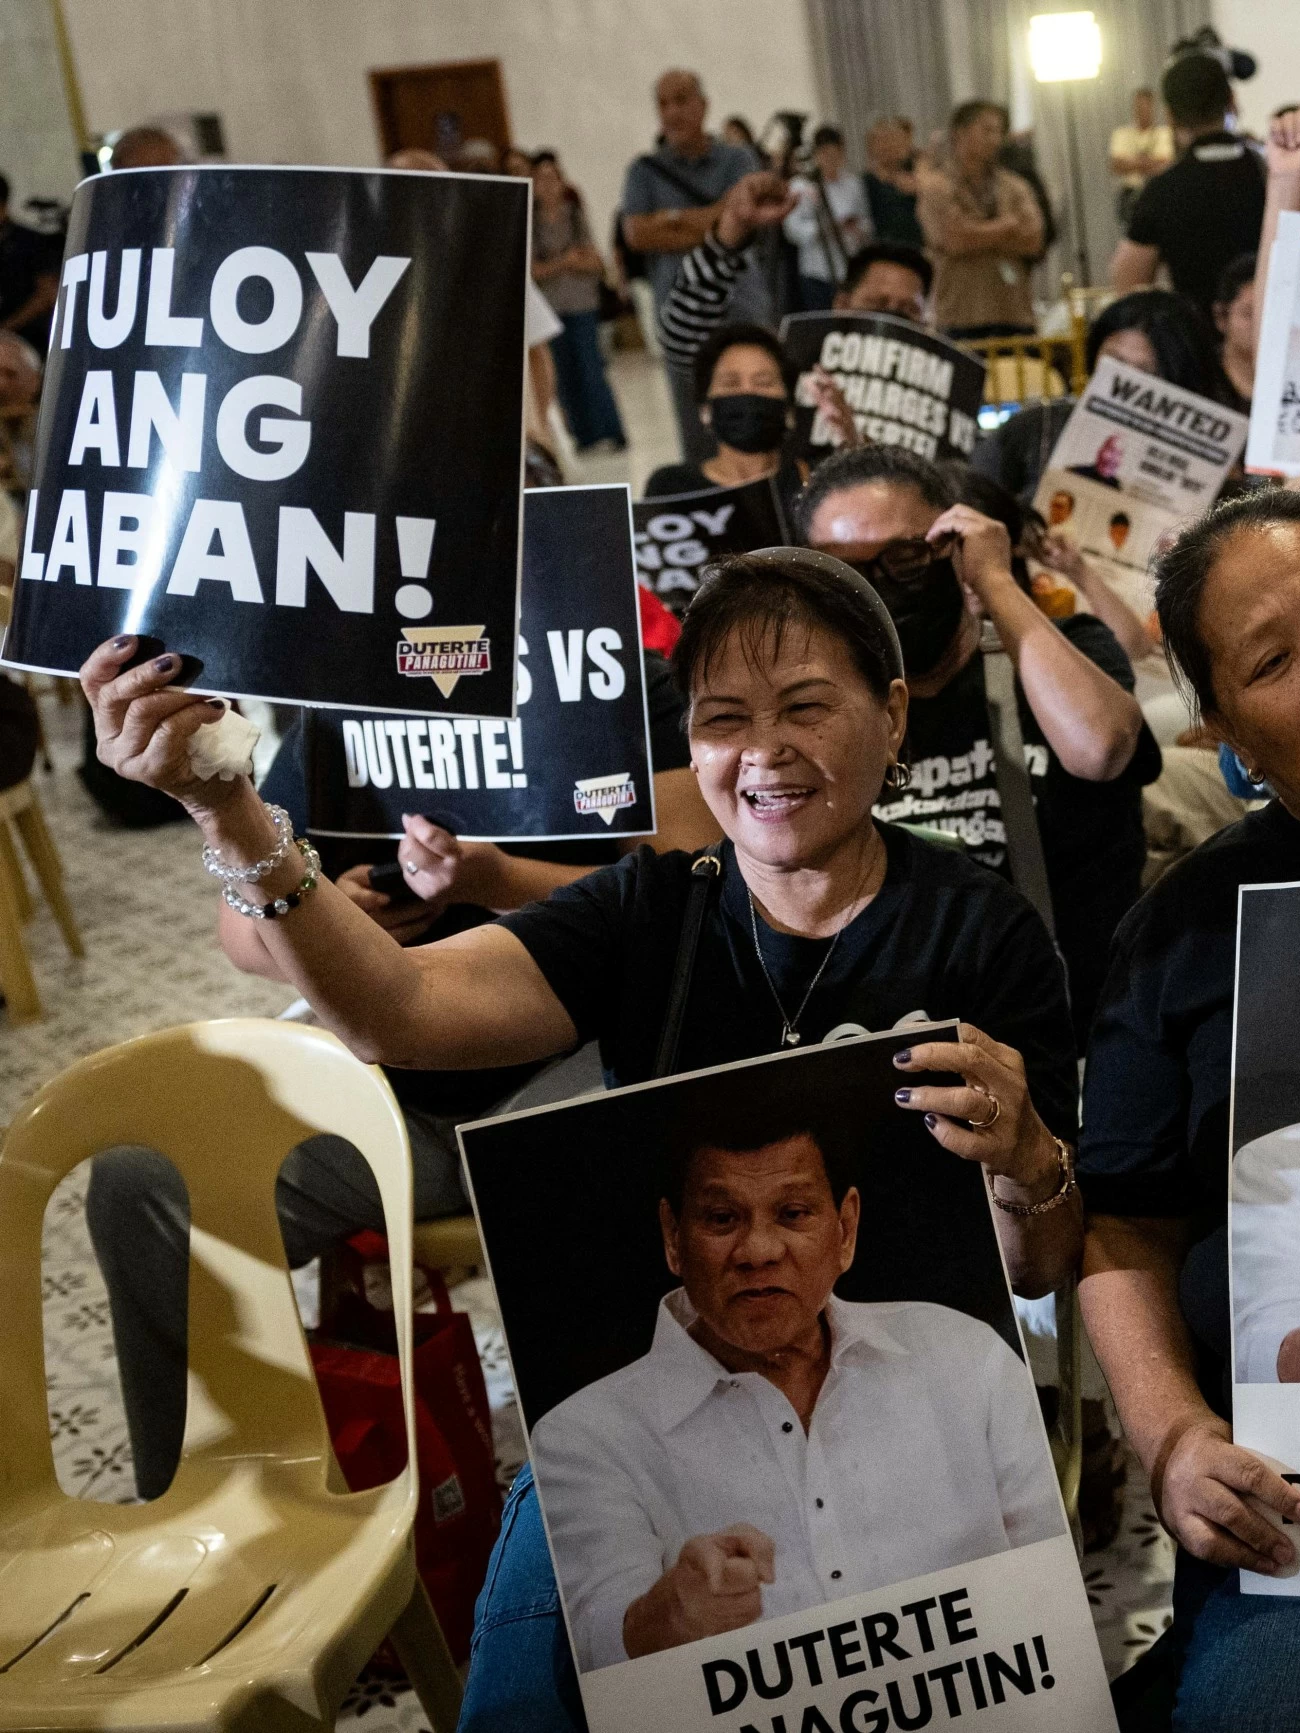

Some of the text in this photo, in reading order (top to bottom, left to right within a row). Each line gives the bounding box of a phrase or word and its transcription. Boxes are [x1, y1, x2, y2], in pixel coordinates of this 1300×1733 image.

[61, 245, 412, 359] TULOY
[820, 331, 954, 400] CONFIRM
[68, 369, 312, 482] ANG
[1110, 374, 1232, 442] WANTED
[21, 489, 437, 620] LABAN!
[399, 641, 488, 655] DUTERTE
[404, 655, 483, 670] PANAGUTIN!
[547, 627, 626, 702] VS
[342, 717, 528, 789] DUTERTE!
[701, 1587, 979, 1716] DUTERTE
